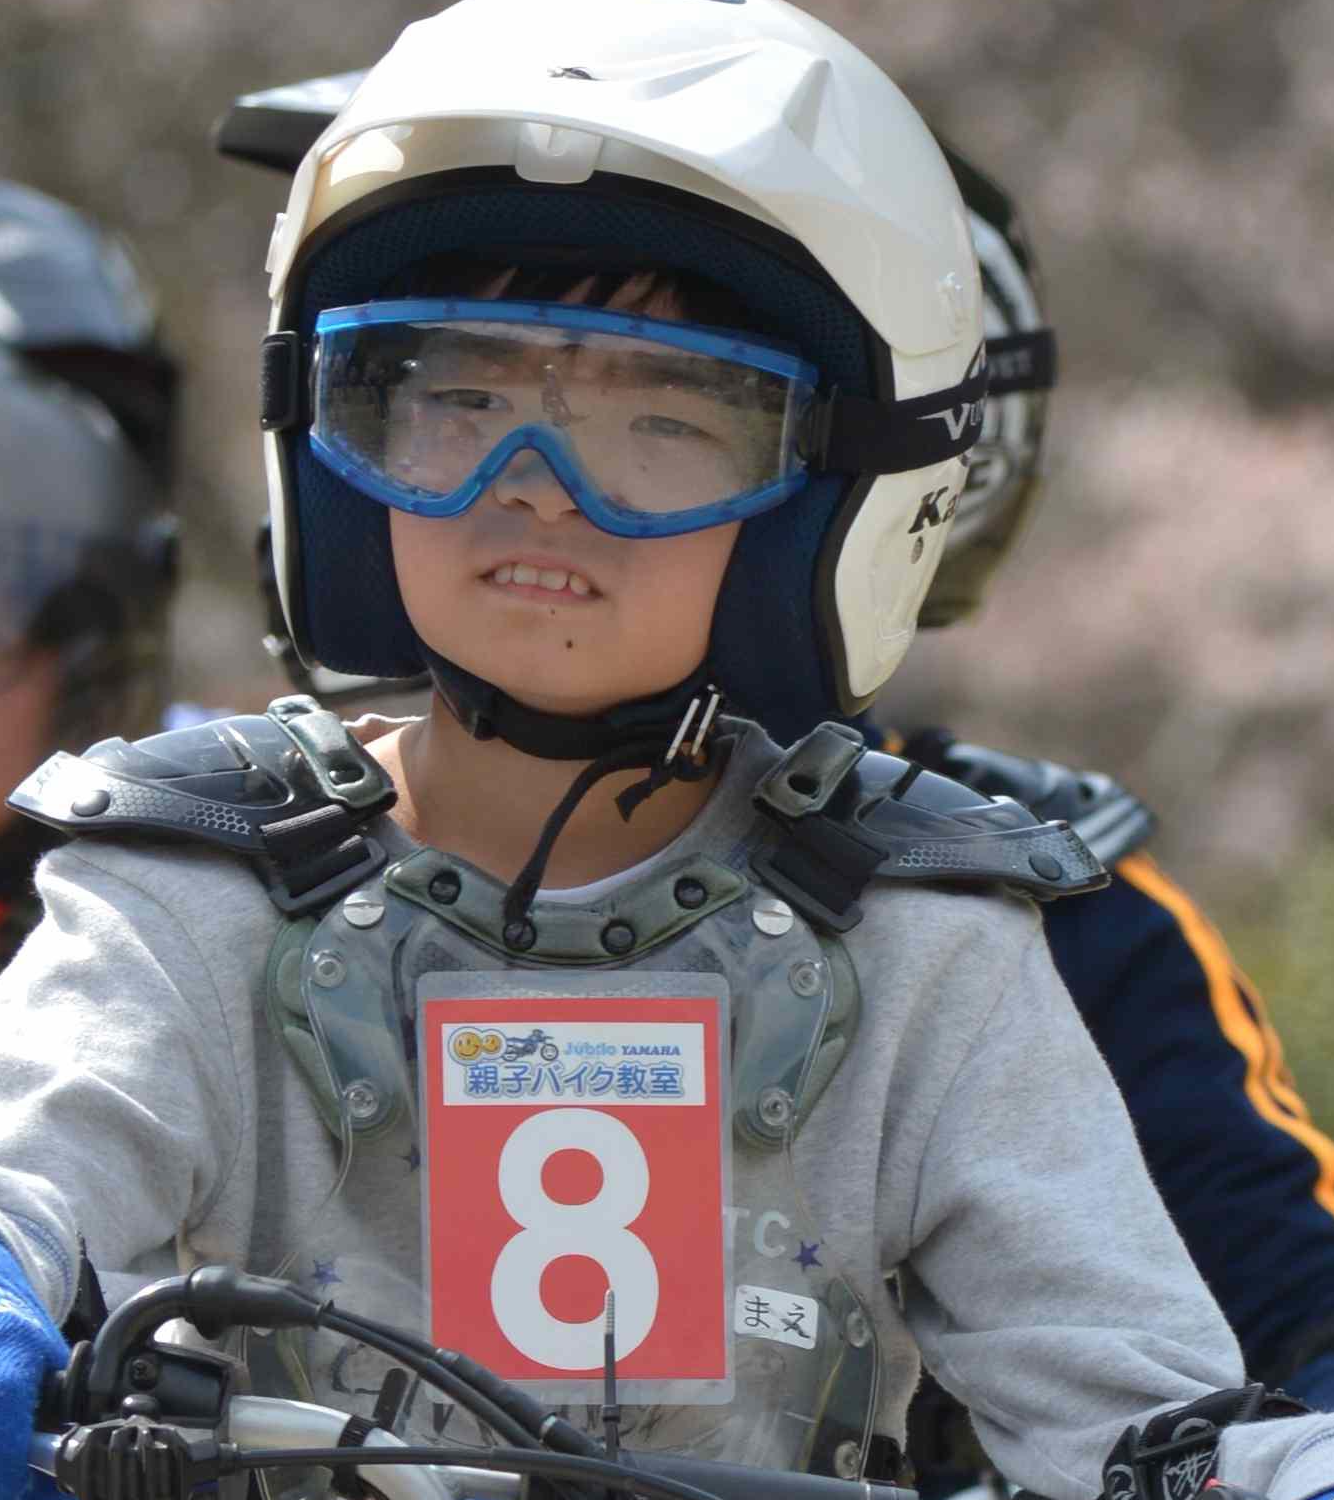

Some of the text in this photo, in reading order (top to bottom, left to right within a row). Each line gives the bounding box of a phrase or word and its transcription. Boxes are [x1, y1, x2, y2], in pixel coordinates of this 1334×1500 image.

[621, 1045, 681, 1056] YAMAHA
[467, 1062, 682, 1096] 親子バイク教室
[490, 1107, 660, 1371] 8
